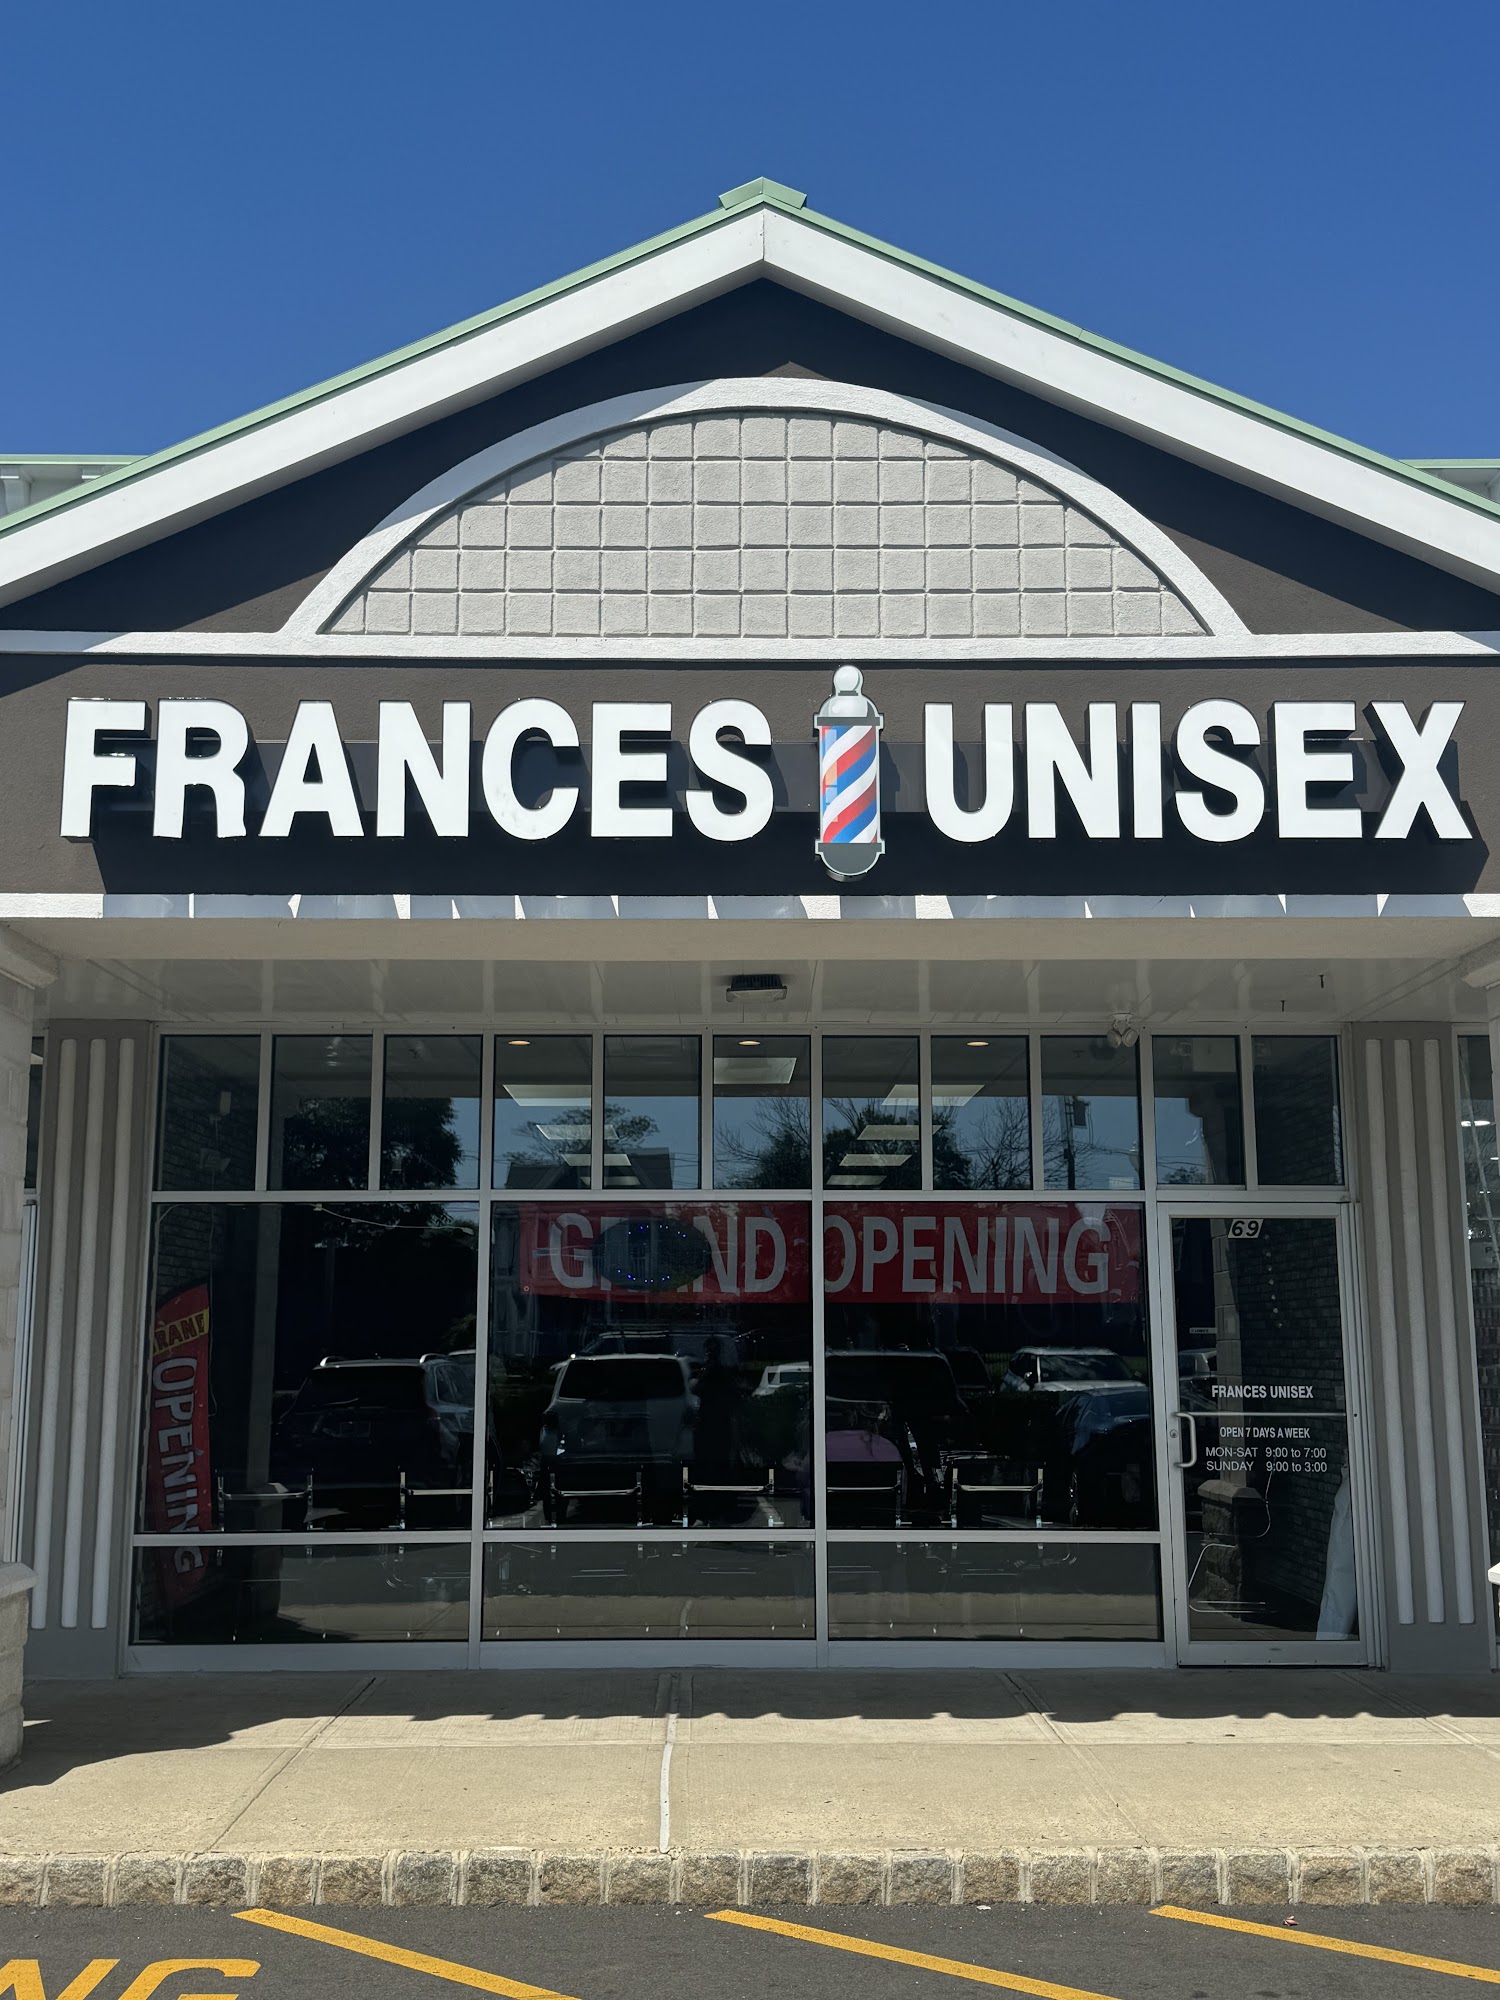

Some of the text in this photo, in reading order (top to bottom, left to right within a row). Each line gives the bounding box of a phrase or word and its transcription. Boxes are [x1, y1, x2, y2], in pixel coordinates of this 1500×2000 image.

[60, 697, 1474, 844] FRANCES UNISEX
[1231, 1220, 1259, 1237] 69
[548, 1212, 787, 1295] GND
[1211, 1385, 1314, 1399] FRANCES UNISEX
[1219, 1426, 1311, 1439] OPEN 7 DAYS A WEEK
[1205, 1446, 1327, 1459] MON-SAT 9:00 to 7:00
[1206, 1460, 1328, 1473] SUNDAY 9:00 to 3:00
